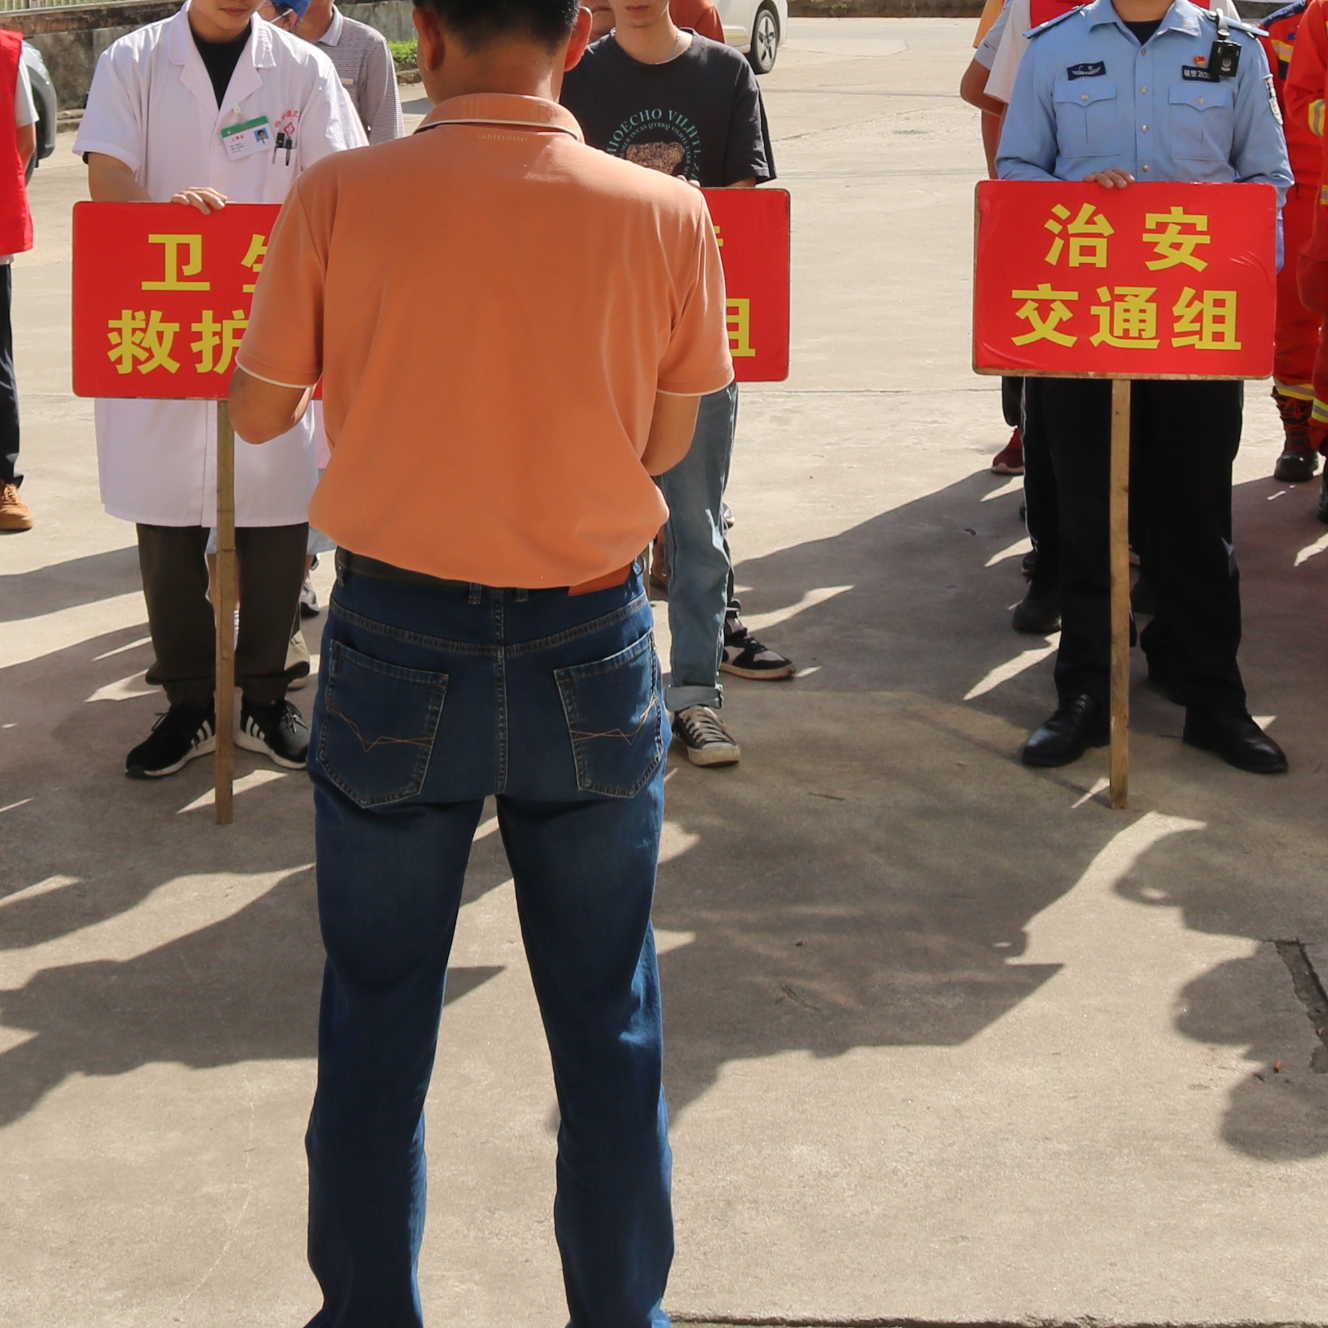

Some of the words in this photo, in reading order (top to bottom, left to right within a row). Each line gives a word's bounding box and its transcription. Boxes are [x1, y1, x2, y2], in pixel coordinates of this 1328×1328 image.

[1044, 203, 1211, 272] 治安
[1011, 283, 1242, 351] 交通组
